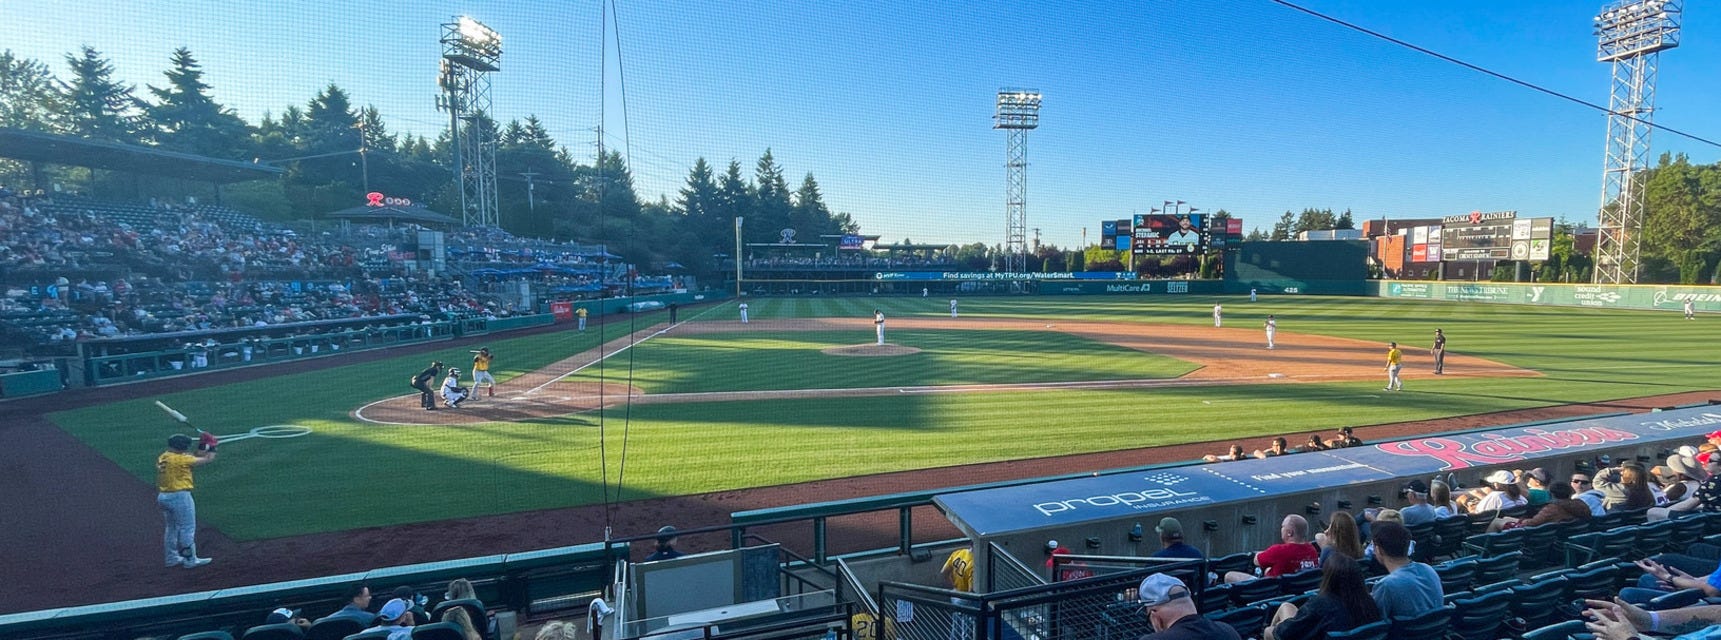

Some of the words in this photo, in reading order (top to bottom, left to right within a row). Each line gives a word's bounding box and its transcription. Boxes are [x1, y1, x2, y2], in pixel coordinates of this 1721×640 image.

[1442, 215, 1470, 224] TACOMA
[1481, 211, 1515, 221] RAINIERS
[1187, 242, 1195, 253] 6
[960, 271, 985, 280] savings
[1106, 284, 1140, 292] MultiCare
[1479, 287, 1509, 295] TRIBUNE
[1374, 426, 1639, 472] Rainiers
[1132, 495, 1211, 510] INSURANCE
[953, 557, 967, 577] 40
